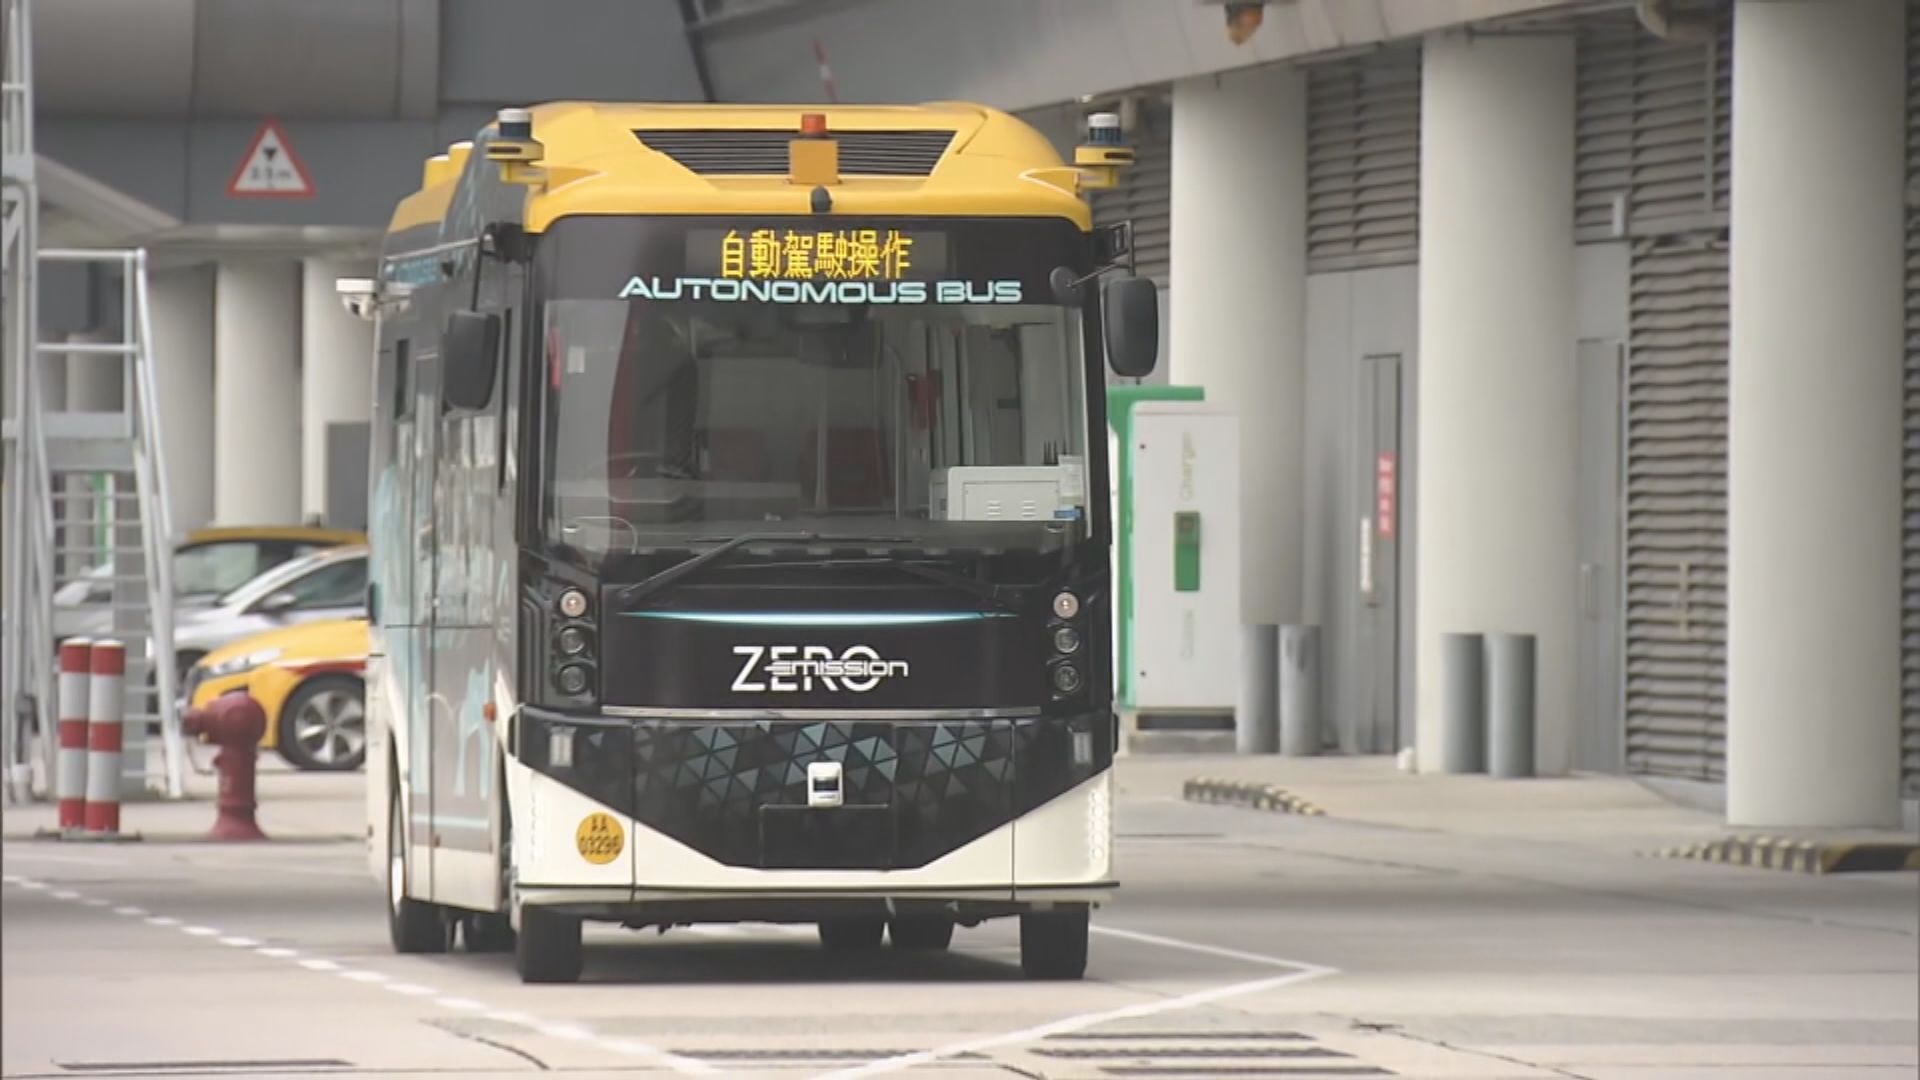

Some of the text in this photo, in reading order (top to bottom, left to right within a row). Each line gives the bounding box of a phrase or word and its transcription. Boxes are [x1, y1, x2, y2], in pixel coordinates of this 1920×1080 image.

[721, 229, 913, 279] 自動駕駛操作
[618, 275, 1022, 304] AUTONOMOUS BUS
[731, 645, 881, 692] ZERO
